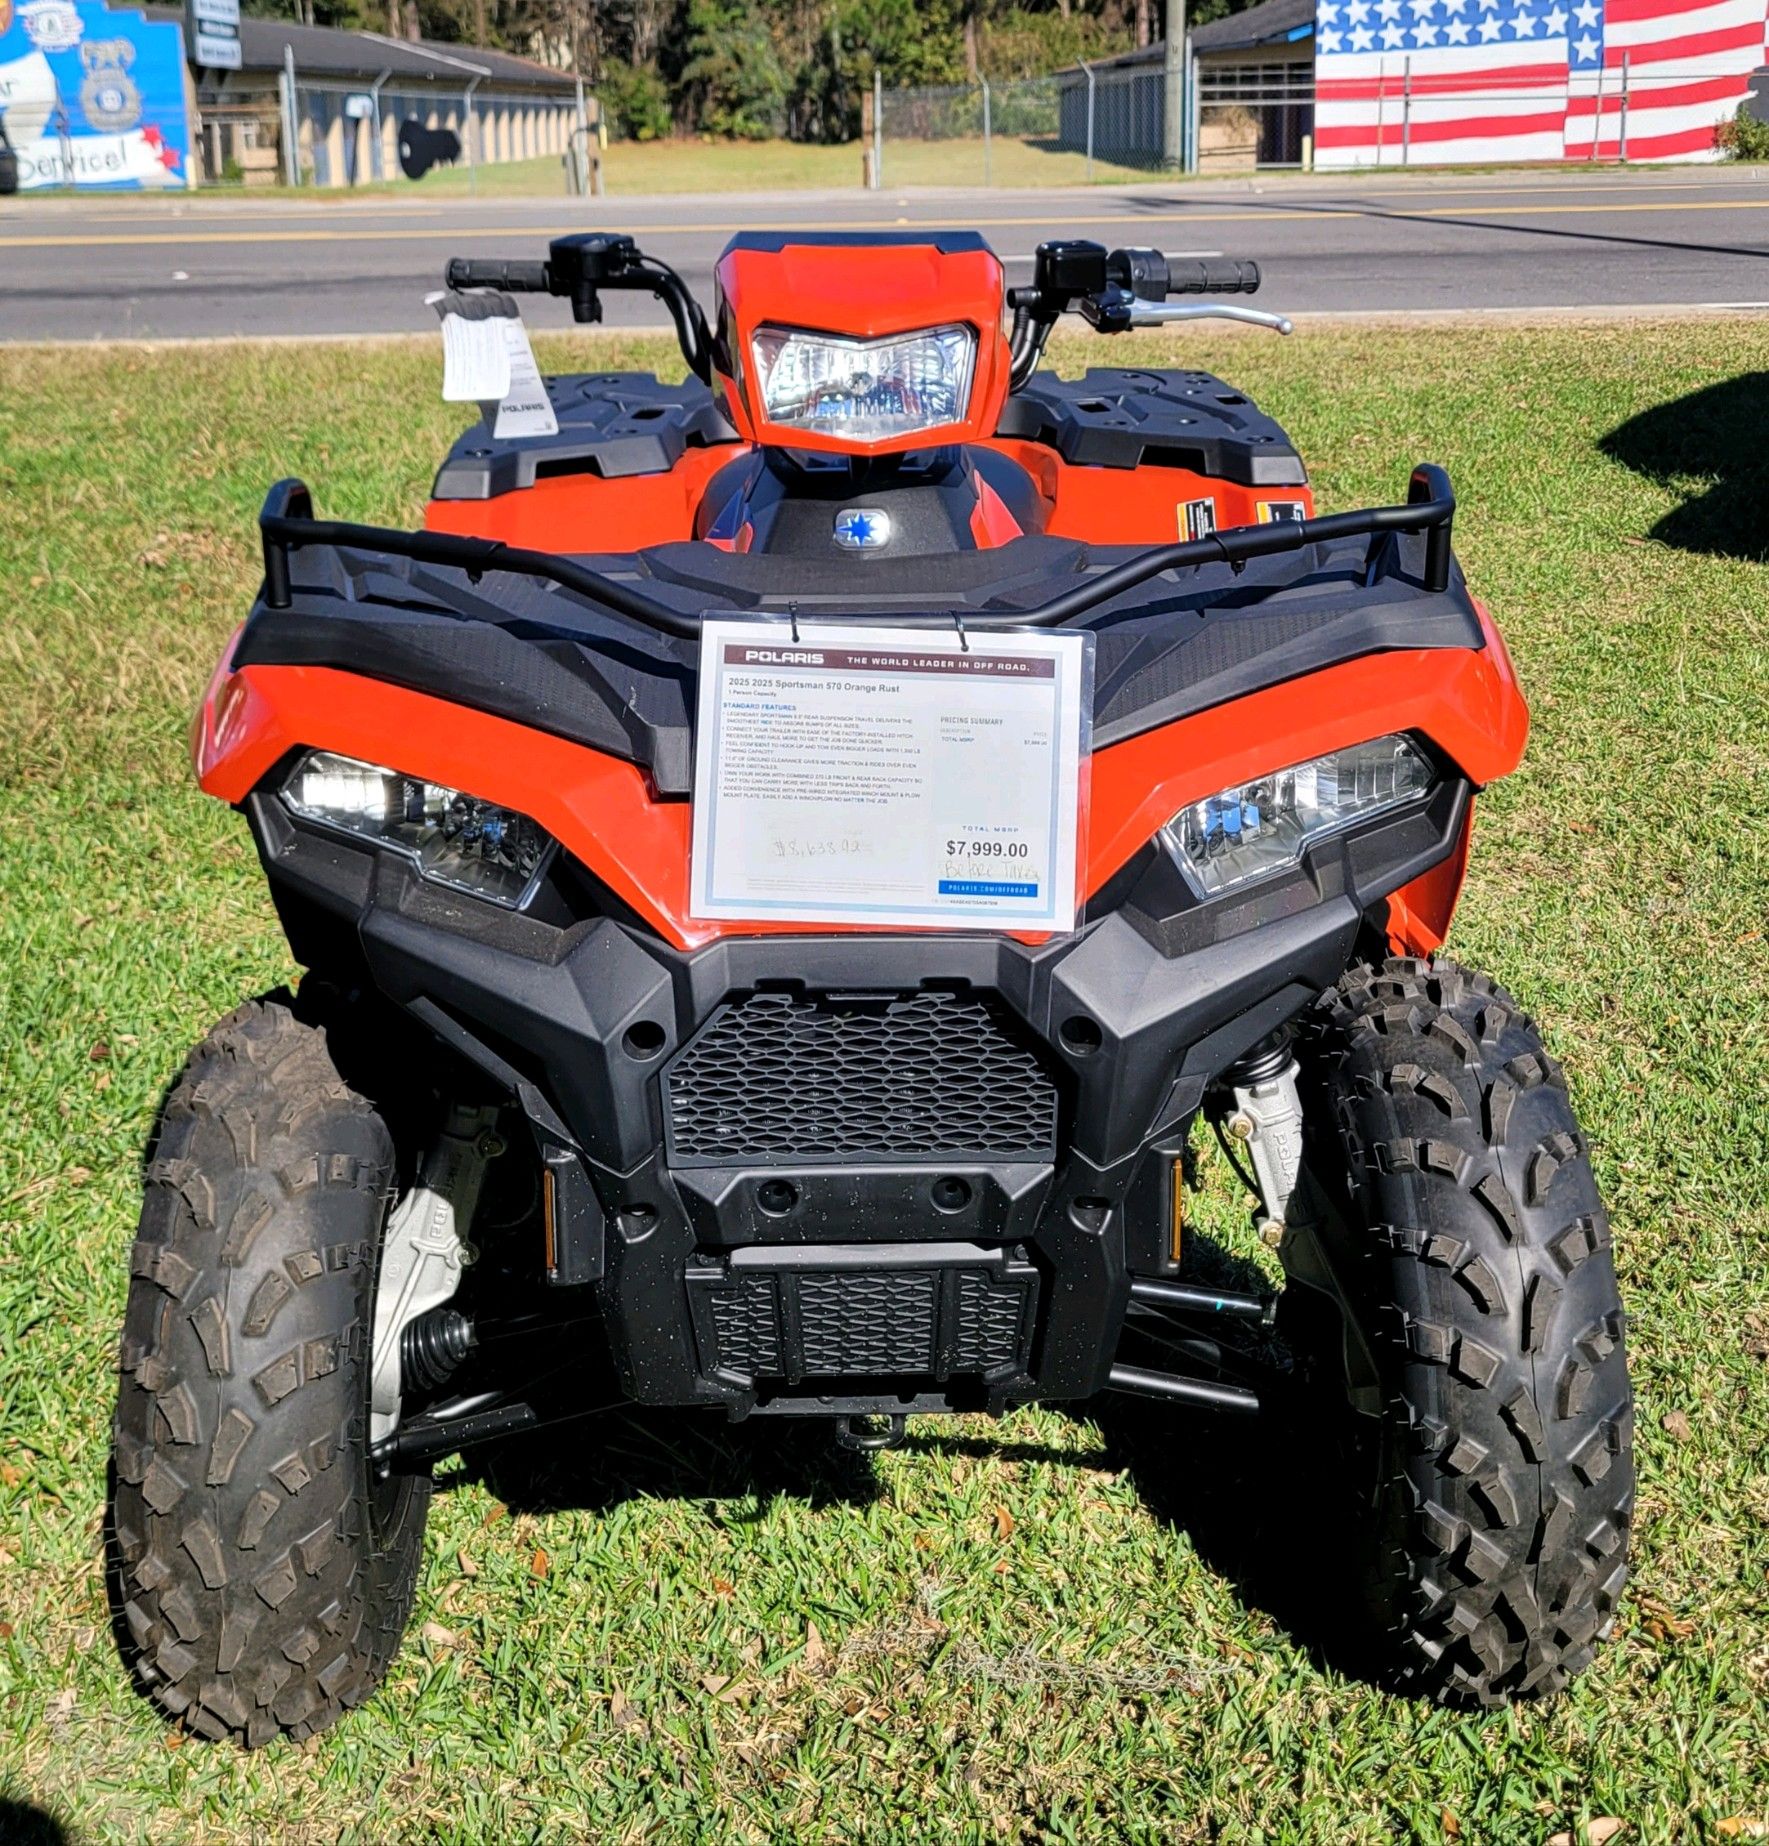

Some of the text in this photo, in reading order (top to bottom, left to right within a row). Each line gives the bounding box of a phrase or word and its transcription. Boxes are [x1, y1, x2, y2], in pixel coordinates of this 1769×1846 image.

[502, 403, 544, 414] POLARIS
[746, 650, 824, 664] POLARIS
[871, 657, 908, 666] WORLD
[913, 659, 954, 668] LEADER
[998, 663, 1030, 671] ROAD.
[728, 678, 900, 693] 2025 2025 Sportsman 570 Orange Rust
[970, 717, 1003, 725] SUMMARY
[946, 840, 1028, 858] $7,999.00
[1272, 1132, 1296, 1188] POLA
